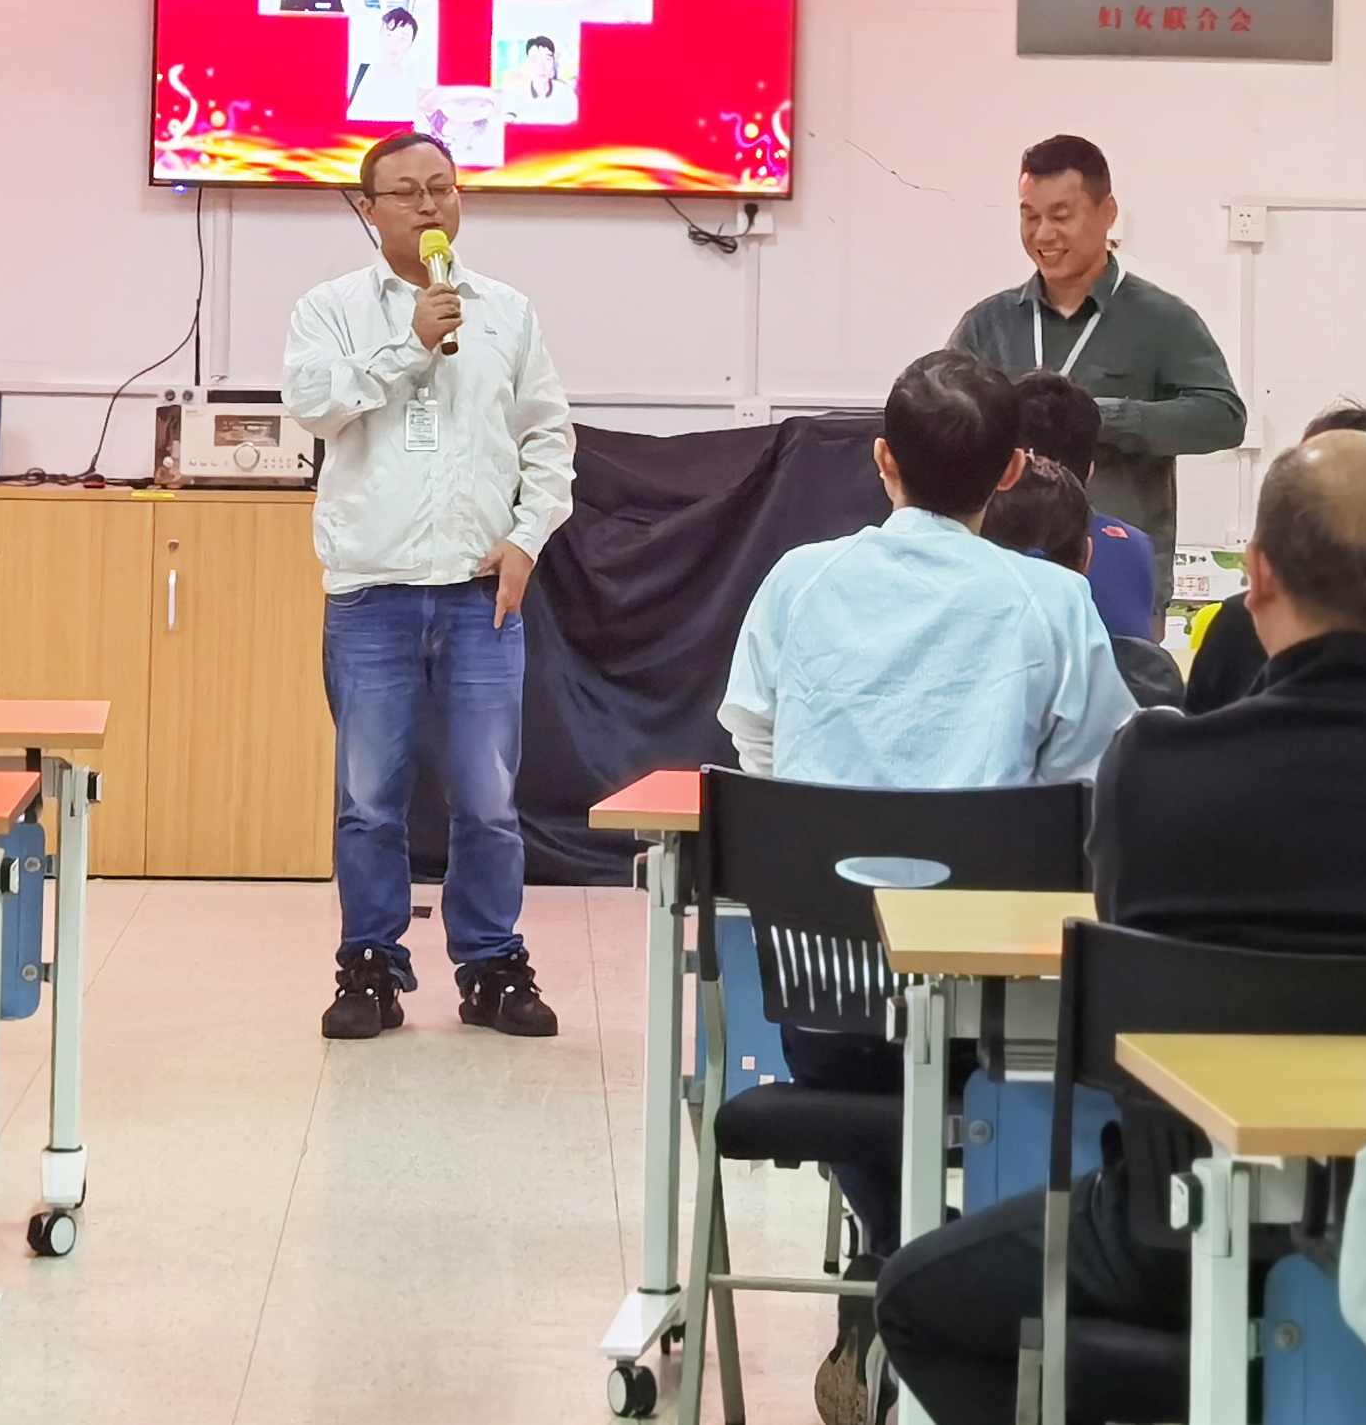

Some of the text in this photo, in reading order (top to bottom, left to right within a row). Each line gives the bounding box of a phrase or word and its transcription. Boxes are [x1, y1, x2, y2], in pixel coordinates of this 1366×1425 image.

[1097, 6, 1253, 32] 妇女联合会
